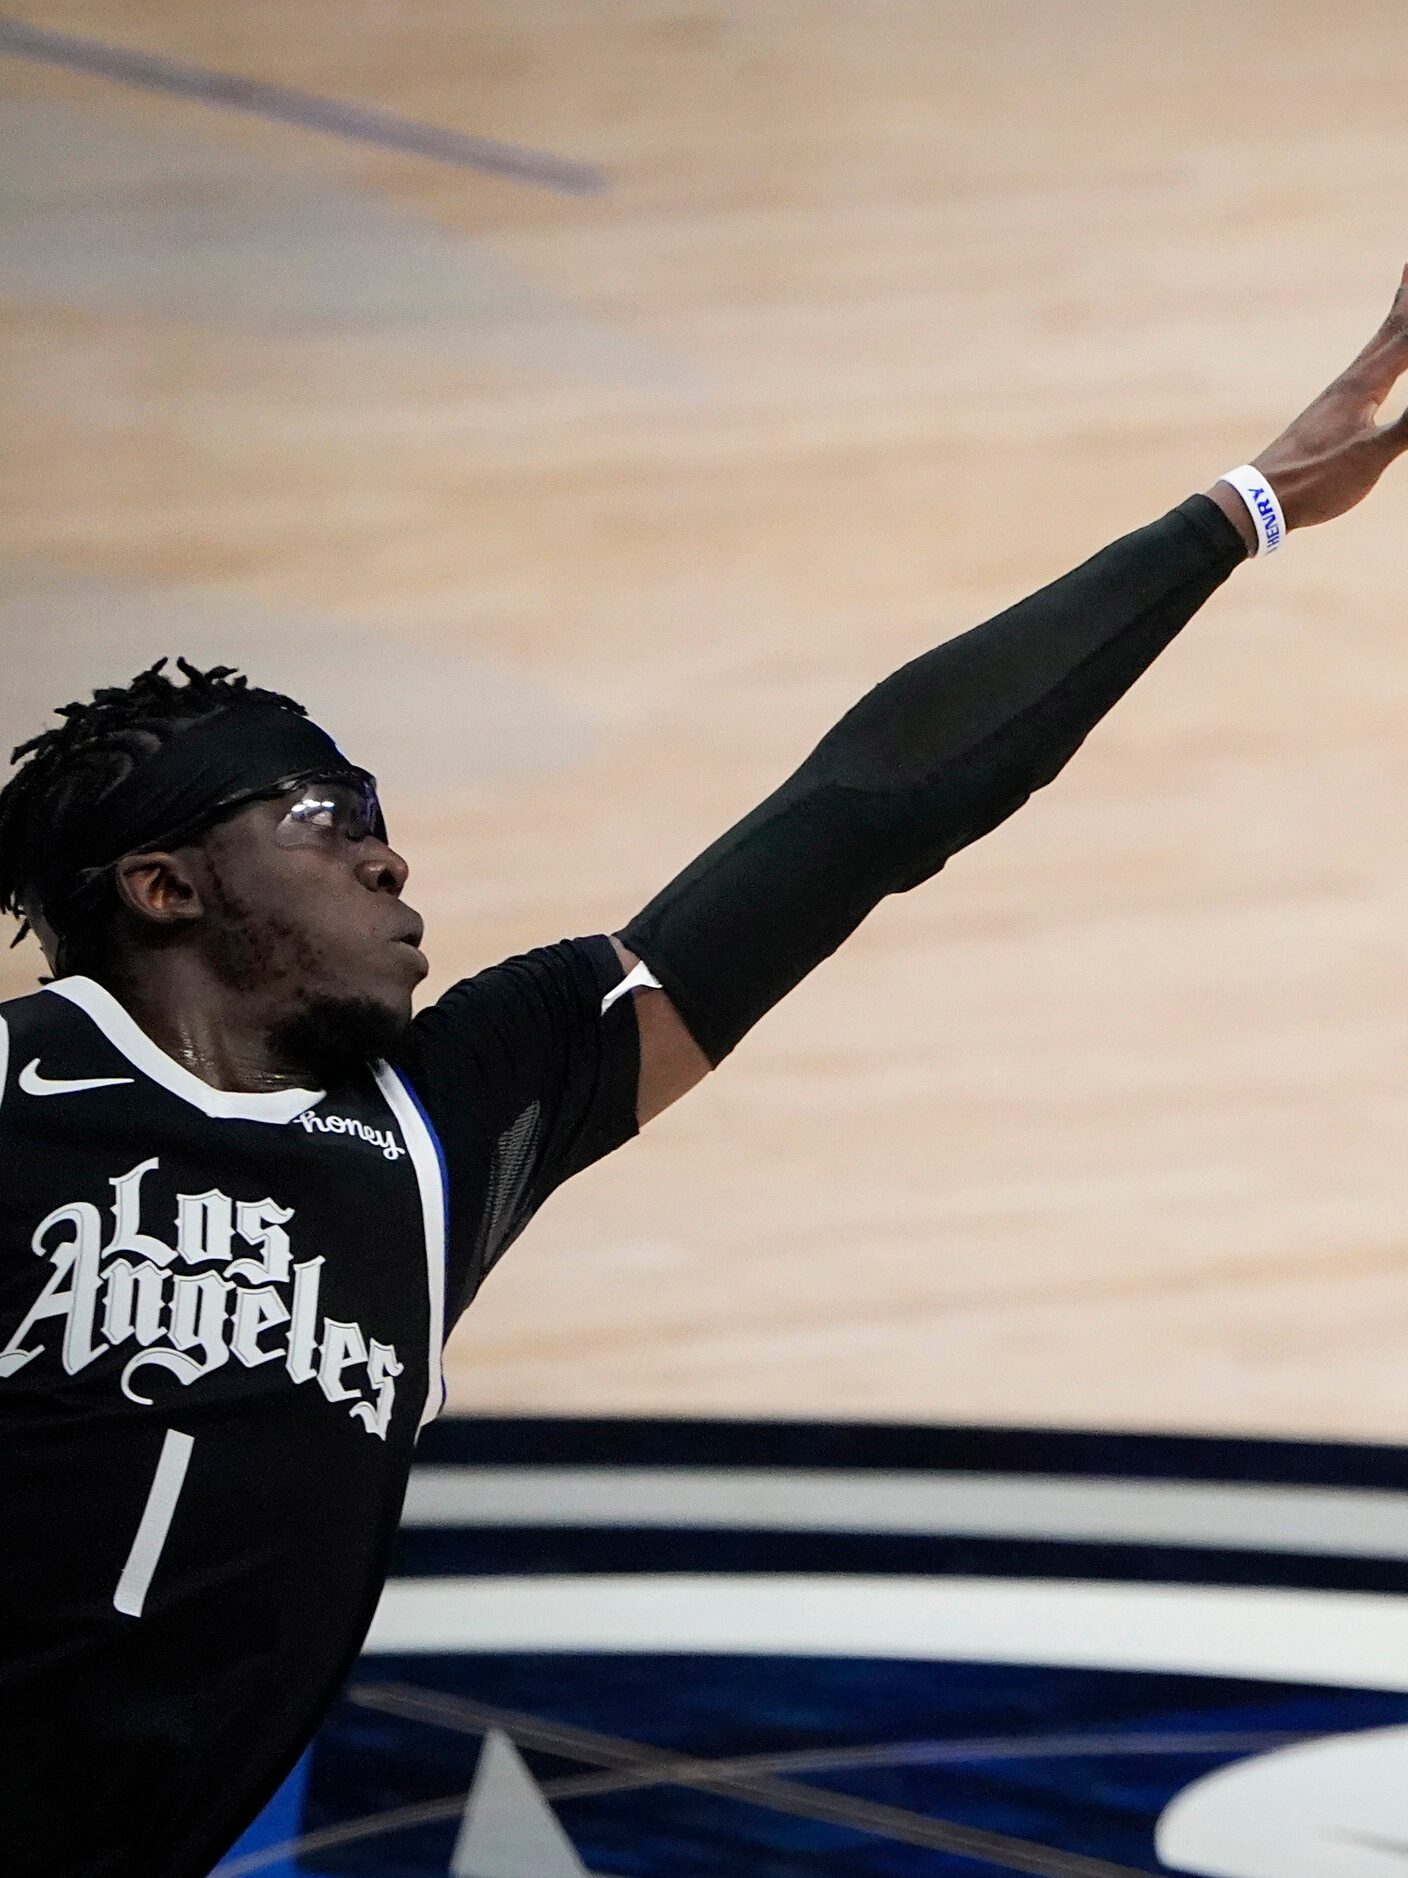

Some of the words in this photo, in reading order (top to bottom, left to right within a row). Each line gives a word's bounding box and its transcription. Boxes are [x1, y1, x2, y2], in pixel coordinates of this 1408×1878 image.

[293, 1110, 405, 1161] honey
[100, 1157, 295, 1283] Los
[0, 1201, 404, 1440] Angeles
[113, 1429, 195, 1617] 1
